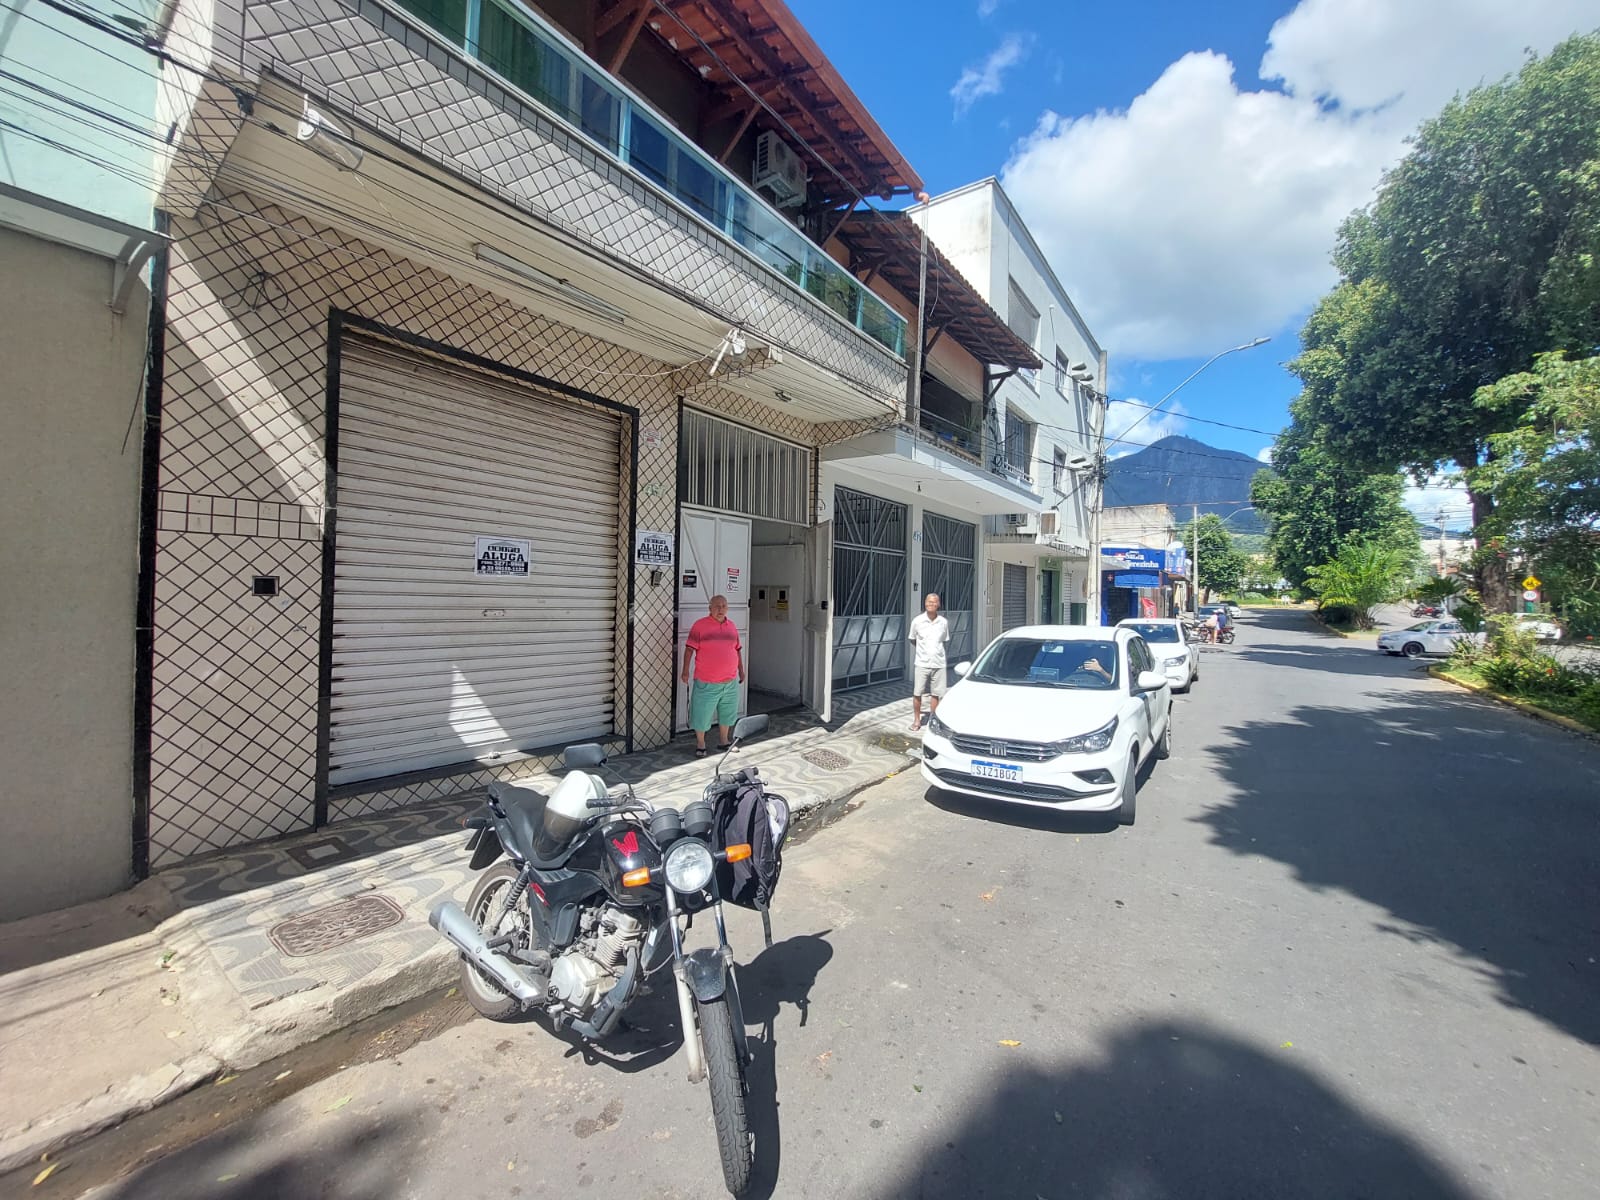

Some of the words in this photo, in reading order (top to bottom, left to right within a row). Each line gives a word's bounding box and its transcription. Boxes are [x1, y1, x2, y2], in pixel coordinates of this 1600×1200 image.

[640, 543, 669, 552] ALUGA
[482, 551, 525, 562] ALUGA
[976, 765, 1017, 781] SIZ1B02
